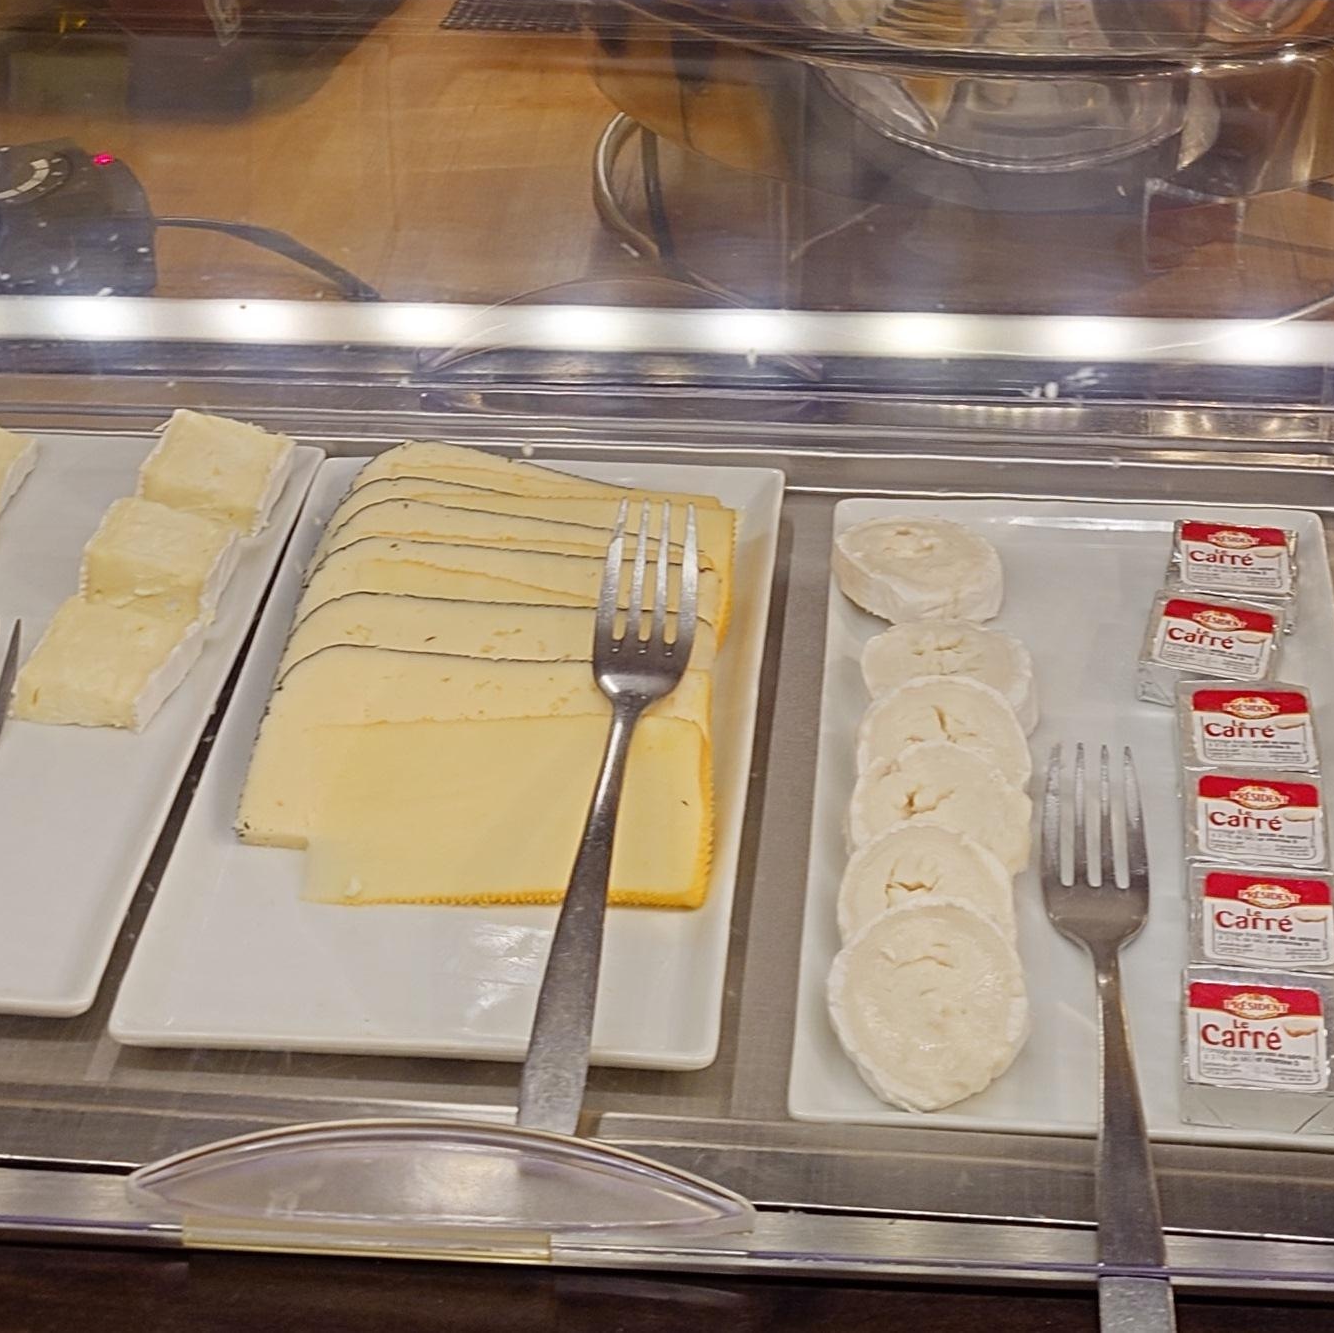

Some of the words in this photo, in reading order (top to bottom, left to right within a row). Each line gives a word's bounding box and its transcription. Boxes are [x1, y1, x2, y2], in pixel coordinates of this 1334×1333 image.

[1189, 550, 1254, 566] Carré
[1168, 627, 1234, 649] Carré
[1204, 722, 1275, 738] Carré
[1209, 811, 1282, 831] Carré
[1215, 910, 1293, 932] Carré
[1201, 1024, 1282, 1051] Carré
